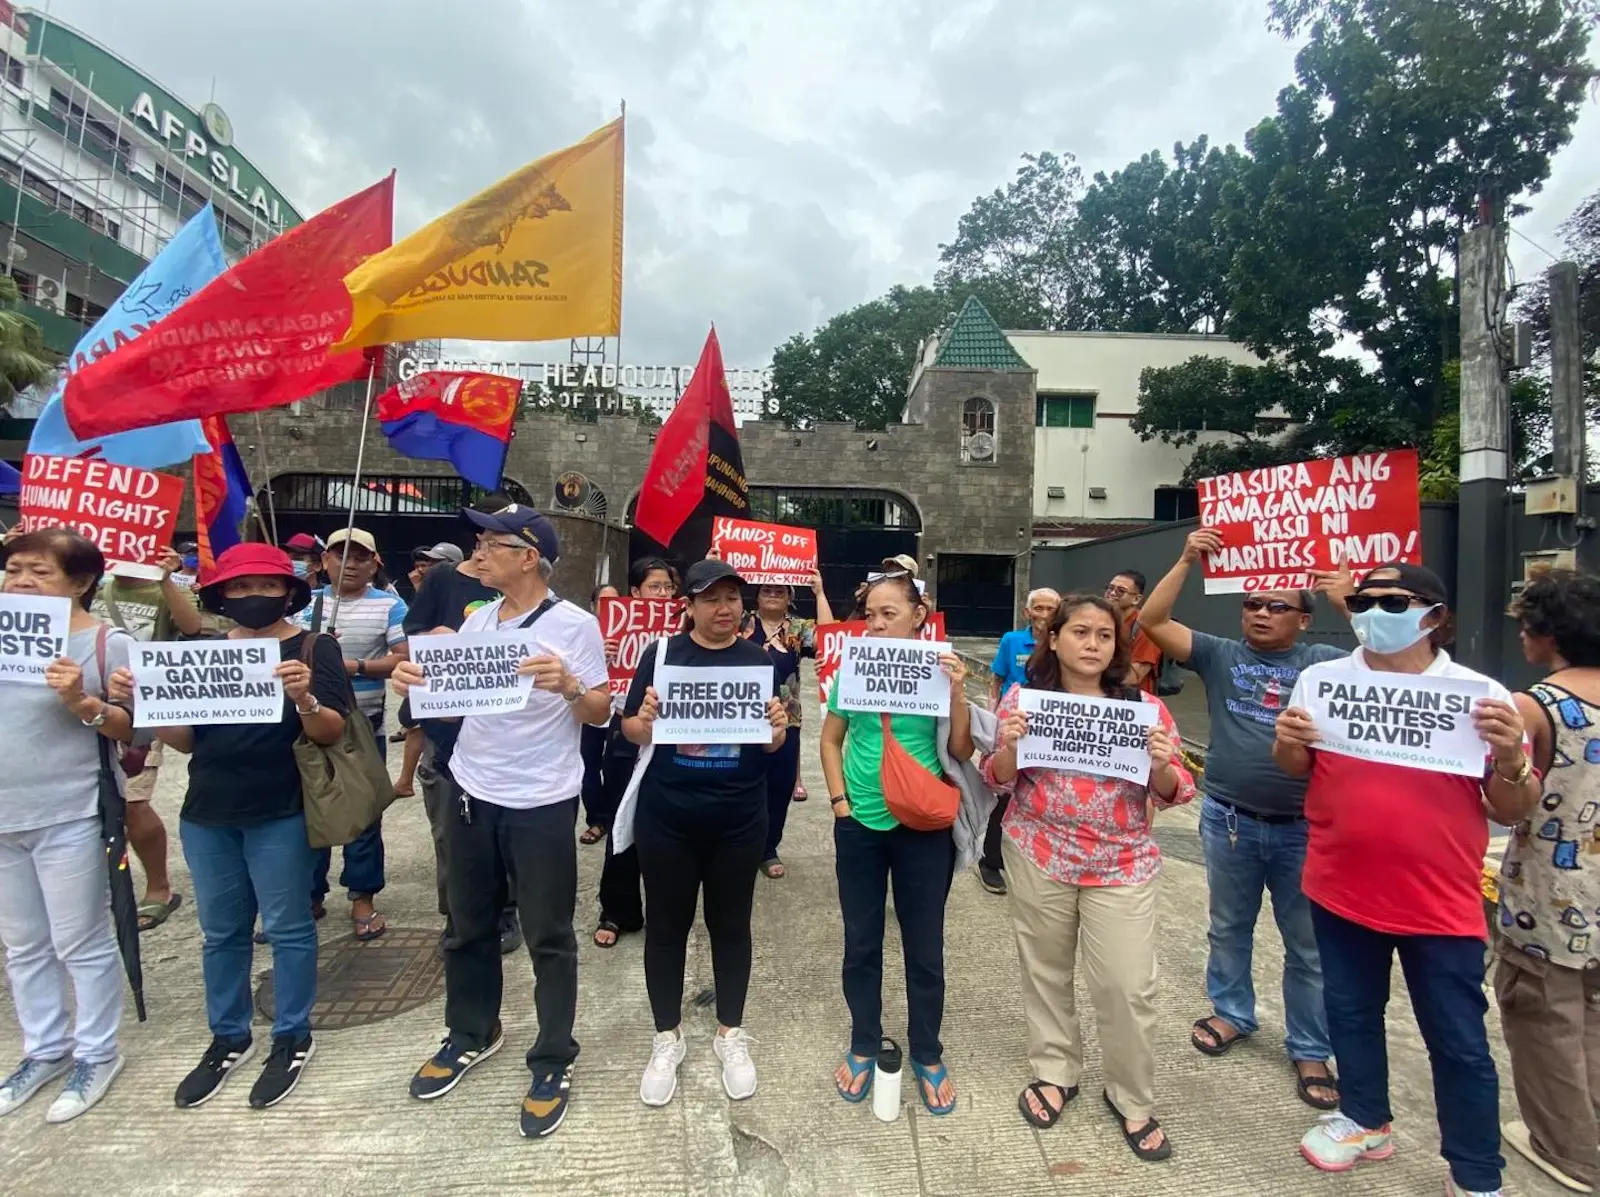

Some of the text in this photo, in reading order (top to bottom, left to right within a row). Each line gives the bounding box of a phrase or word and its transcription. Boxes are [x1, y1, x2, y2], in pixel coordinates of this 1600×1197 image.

[130, 91, 279, 224] AFPSLAI
[542, 361, 774, 392] HEADQUARRS
[559, 391, 586, 409] OF
[595, 393, 635, 410] THE
[28, 455, 160, 498] DEFEND
[1200, 453, 1390, 503] IBASURA ANG
[21, 483, 170, 528] HUMAN RIGHTS
[1201, 482, 1376, 527] GAWAGAWANG
[1252, 512, 1348, 543] KASO NI
[21, 514, 157, 563] DEDERS!
[782, 533, 810, 548] OFF
[1207, 540, 1316, 573] MARITESS
[1243, 573, 1315, 592] OLALI
[0, 610, 51, 634] OUR
[0, 634, 63, 658] STS!
[415, 644, 530, 664] KARAPATAN SA
[849, 646, 922, 664] PALAYAIN
[142, 647, 266, 667] PALAYAIN SI
[0, 663, 45, 674] AYO UN
[165, 667, 244, 684] GAVINO
[422, 660, 520, 678] AG-OORGANIS
[855, 662, 932, 680] MARITESS
[140, 682, 276, 701] PANGANIBAN!
[430, 675, 519, 693] IPAGLABAN!
[668, 682, 761, 700] FREE OUR
[866, 678, 918, 695] DAVID!
[420, 695, 523, 711] KILUSANG MAYO UNO
[843, 697, 940, 711] KILUSANG MAYO UNO
[1318, 681, 1471, 714] PALAYAIN SI
[148, 708, 274, 720] KILUSANG MAYO UNO
[658, 702, 769, 720] UNIONISTS!
[1040, 699, 1135, 722] UPHOLD AND
[1328, 702, 1455, 731] MARITESS
[1026, 711, 1149, 738] PROTECT TRADE
[1026, 724, 1064, 740] NION
[1064, 730, 1097, 743] AND
[1348, 722, 1431, 749] DAVID!
[1052, 740, 1113, 758] RIGHTS!
[1355, 746, 1371, 755] NA
[1374, 749, 1464, 769] MANGGAGAWA
[1024, 752, 1139, 774] KILUSANG MAYO UNO
